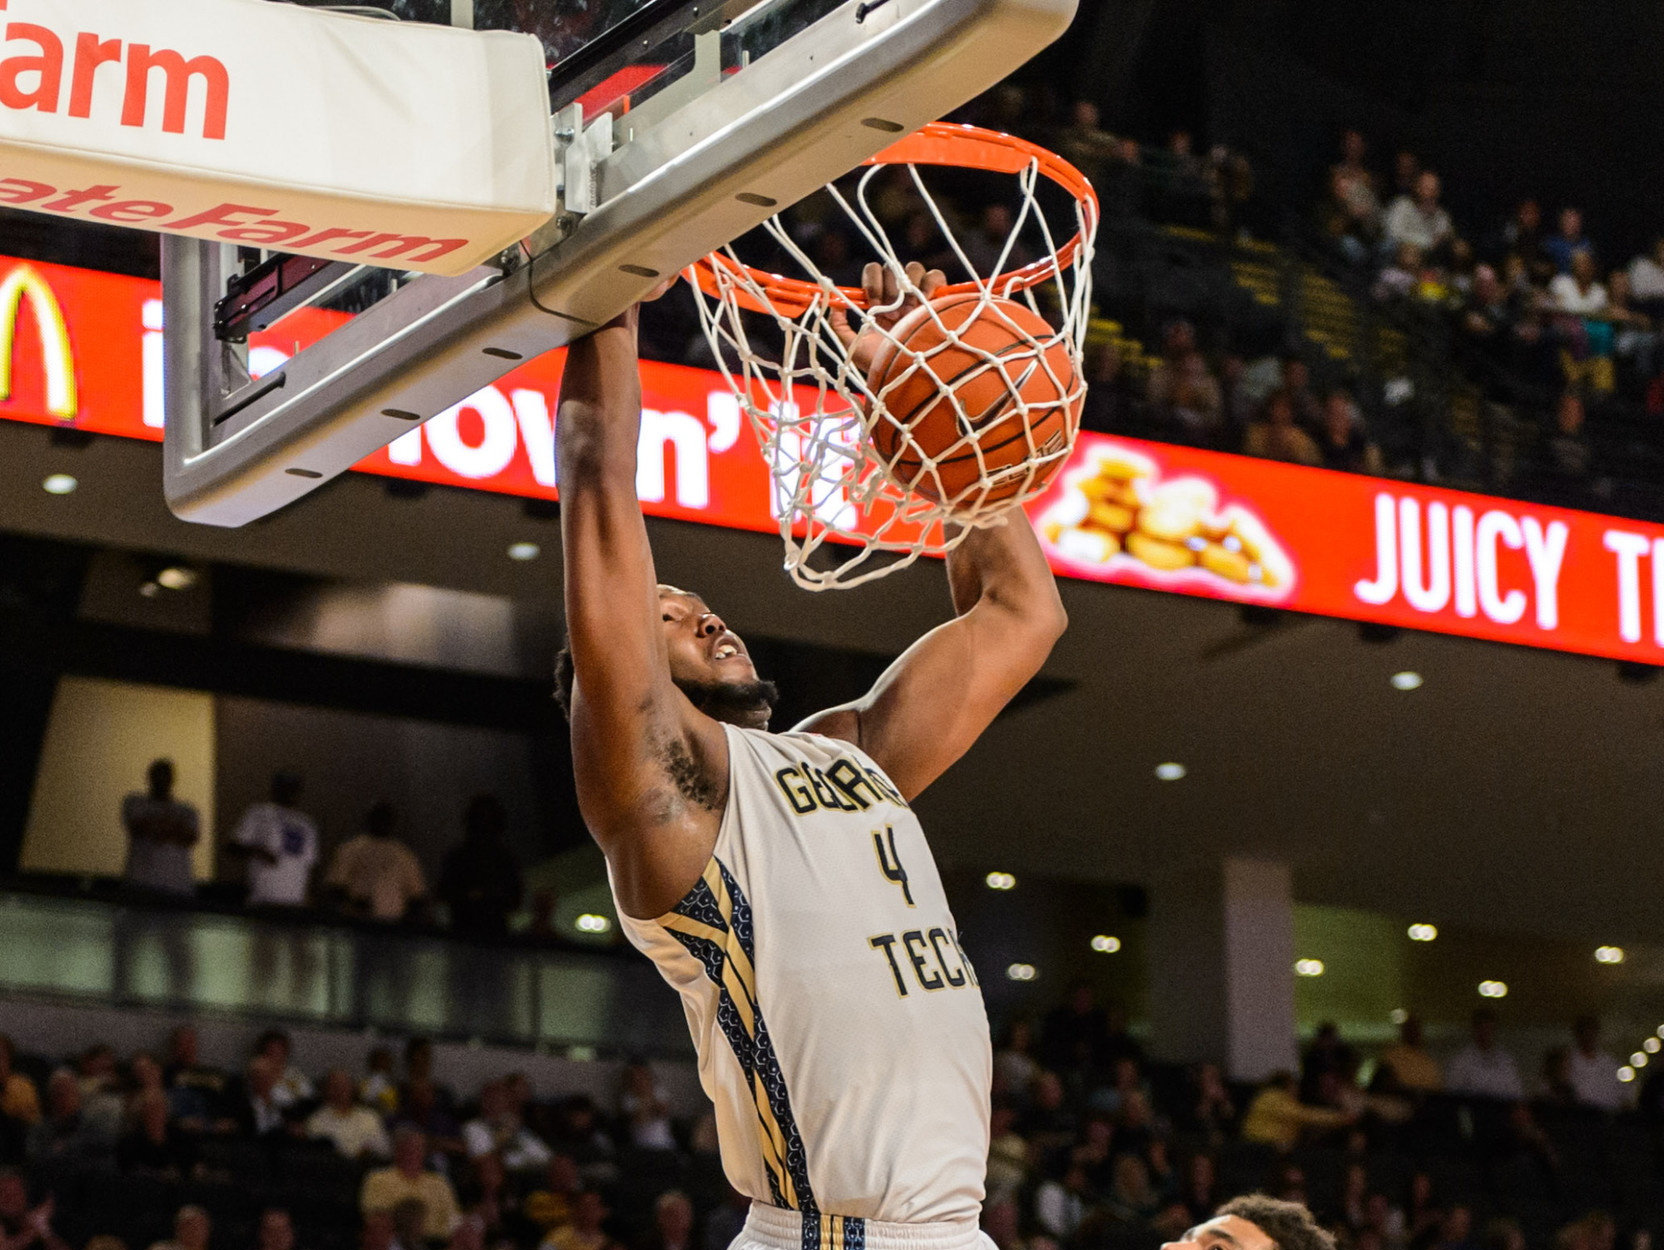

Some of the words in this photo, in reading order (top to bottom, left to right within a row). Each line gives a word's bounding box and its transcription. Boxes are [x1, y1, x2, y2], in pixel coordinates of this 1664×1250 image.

[0, 0, 229, 140] arm
[1354, 492, 1569, 630] JUICY
[1603, 529, 1664, 648] T
[871, 823, 917, 909] 4
[867, 928, 980, 1000] TEC
